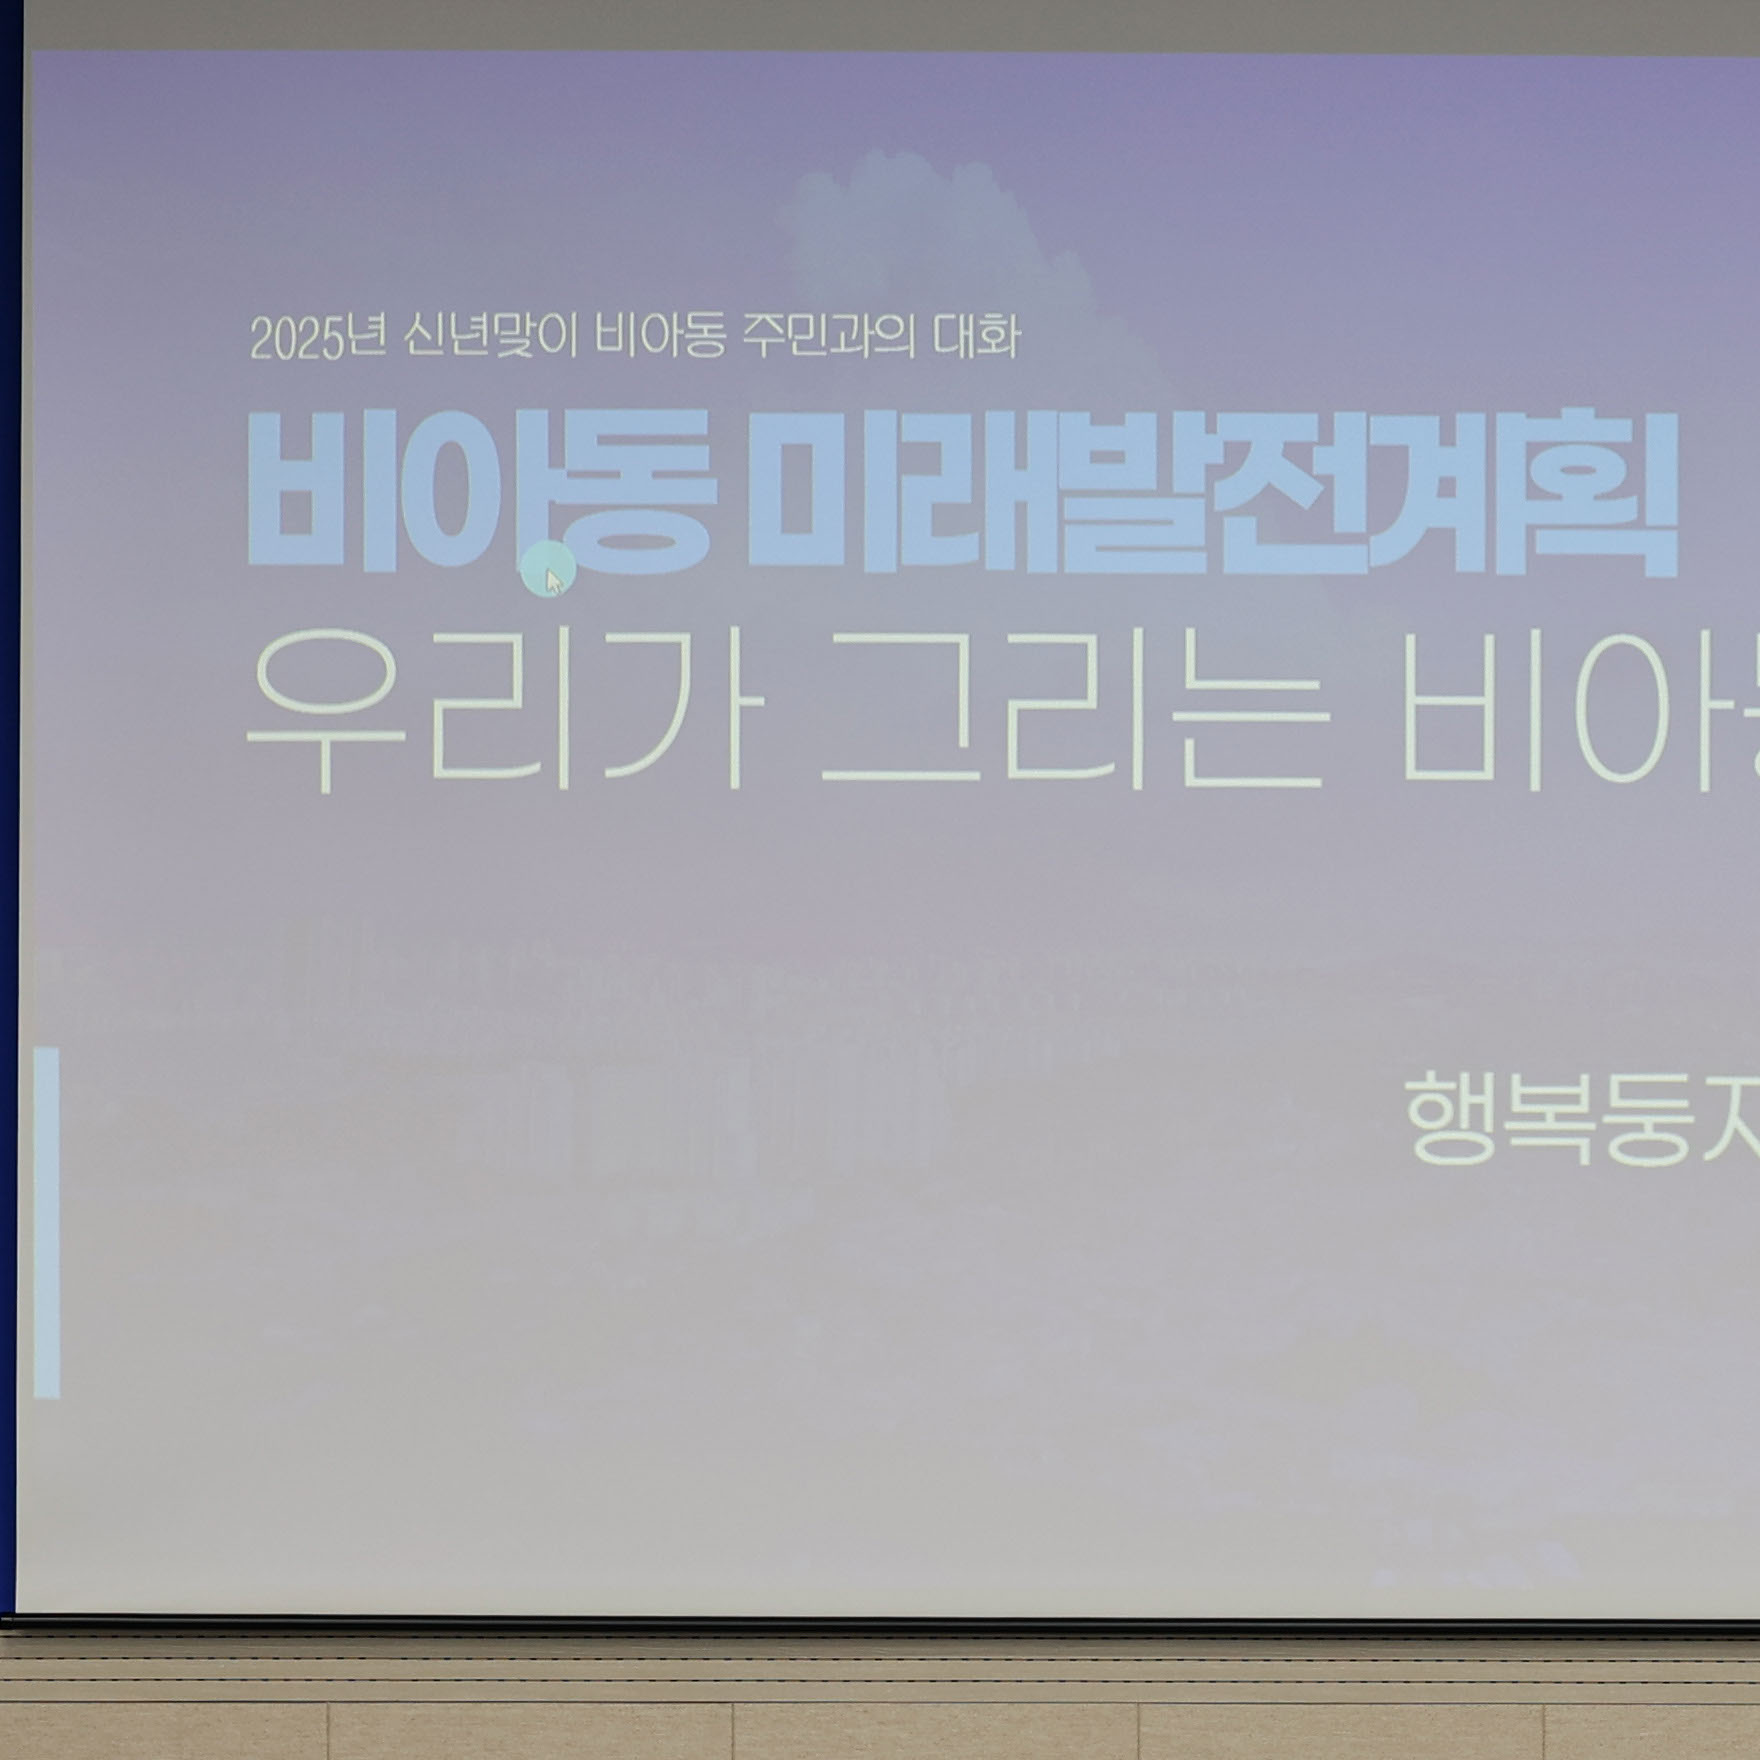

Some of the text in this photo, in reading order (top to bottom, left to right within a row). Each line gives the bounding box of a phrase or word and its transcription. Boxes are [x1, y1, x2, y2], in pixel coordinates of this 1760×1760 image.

[250, 311, 1023, 361] 2025년 신년맞이 비아동 주민과의 대화
[248, 406, 1679, 579] 비아동 미래발전계획
[246, 625, 766, 795] 우리가
[821, 626, 1332, 792] 그리는
